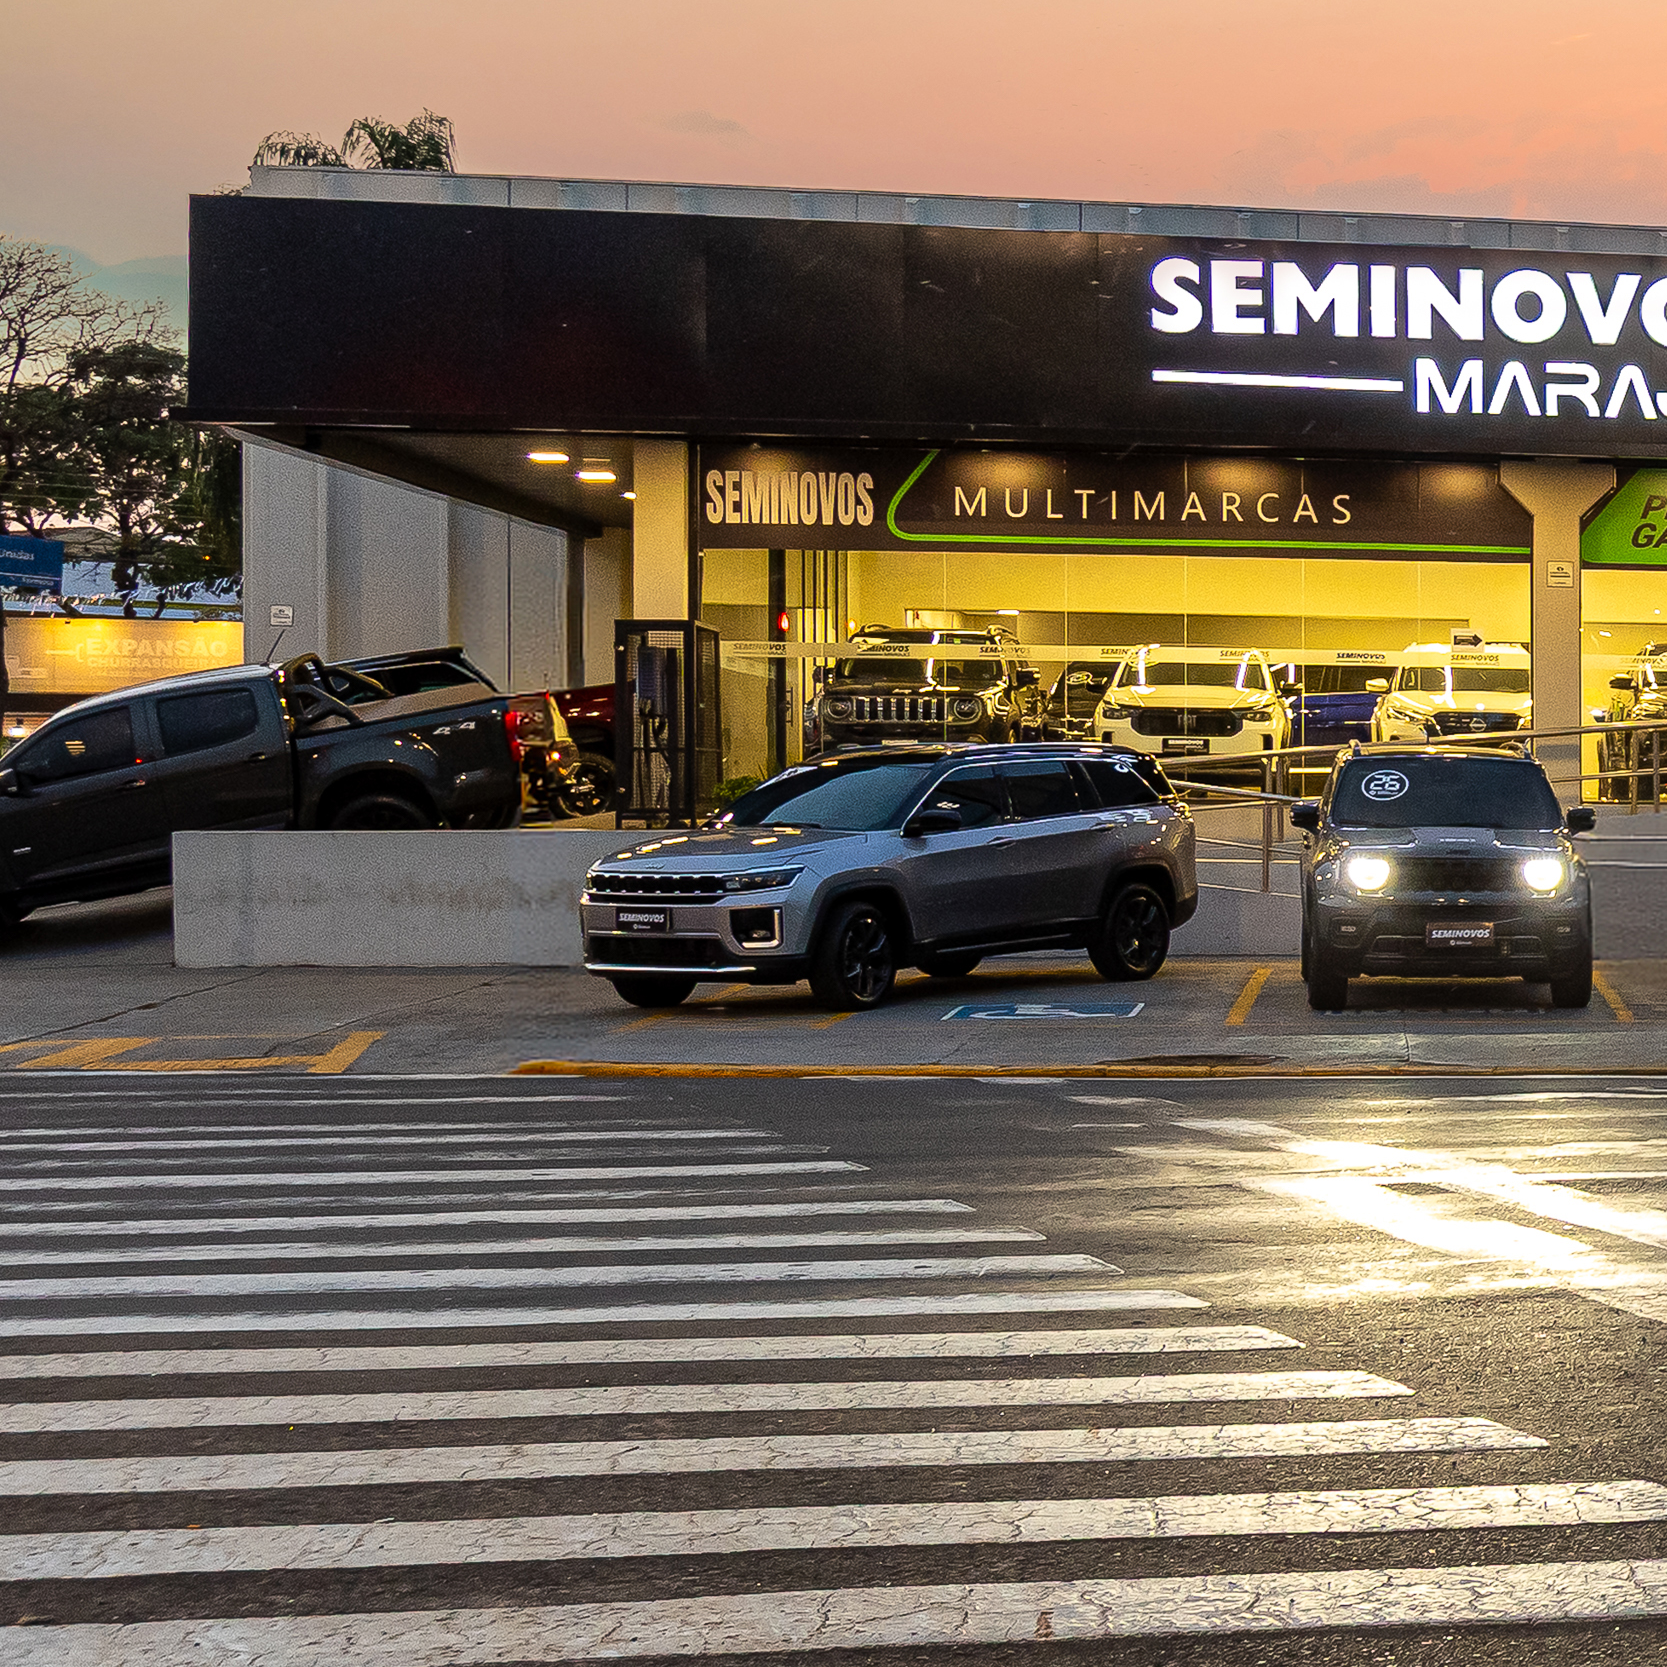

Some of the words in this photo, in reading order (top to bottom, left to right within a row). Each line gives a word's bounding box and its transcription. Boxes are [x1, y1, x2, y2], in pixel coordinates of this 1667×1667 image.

[705, 469, 873, 526] SEMINOVOS
[953, 487, 1352, 524] MULTIMARCAS
[86, 636, 229, 657] EXPANSÃO
[618, 913, 665, 923] SEMINOVOS
[1431, 929, 1491, 939] SEMINOVOS
